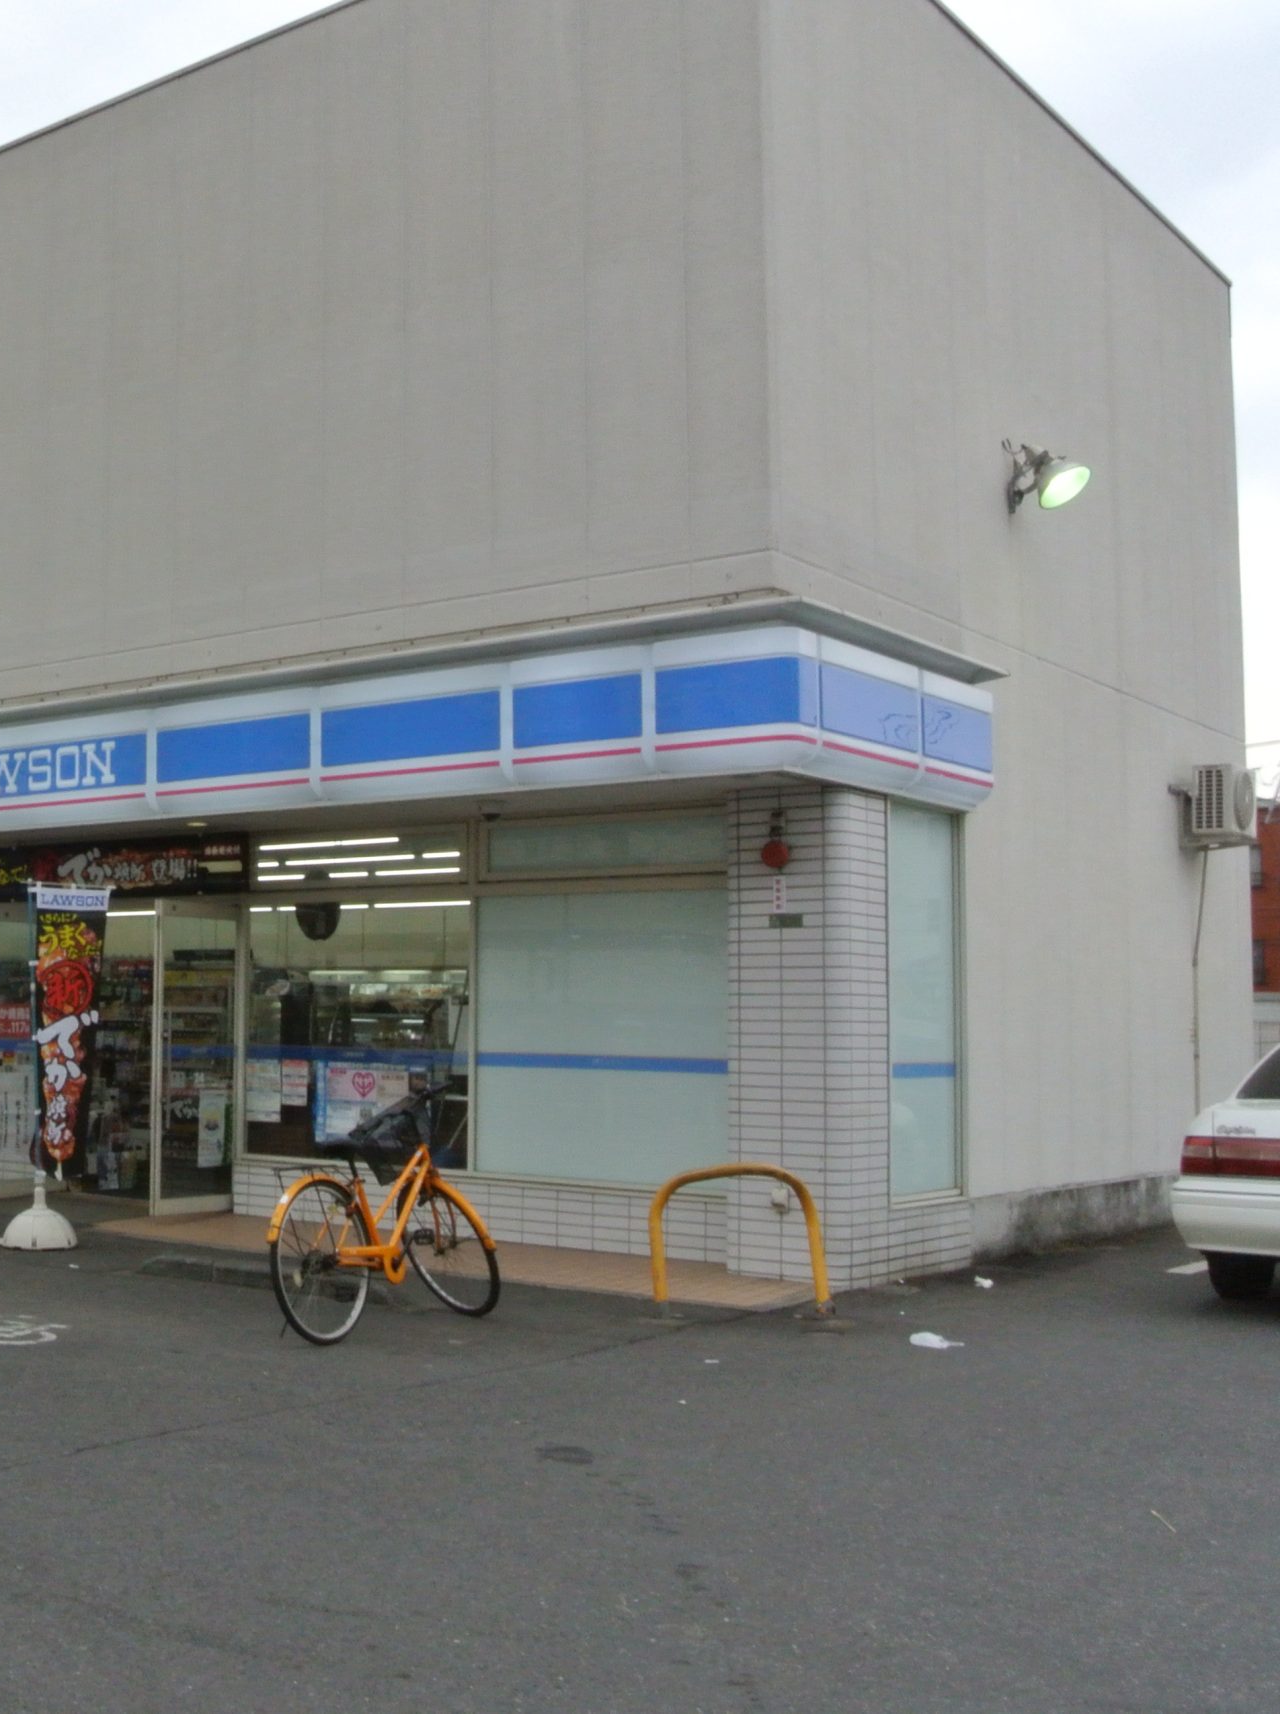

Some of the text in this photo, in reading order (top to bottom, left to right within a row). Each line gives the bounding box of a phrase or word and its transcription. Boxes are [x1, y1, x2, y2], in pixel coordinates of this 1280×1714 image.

[41, 893, 105, 907] LAWSON
[39, 922, 87, 956] うまく
